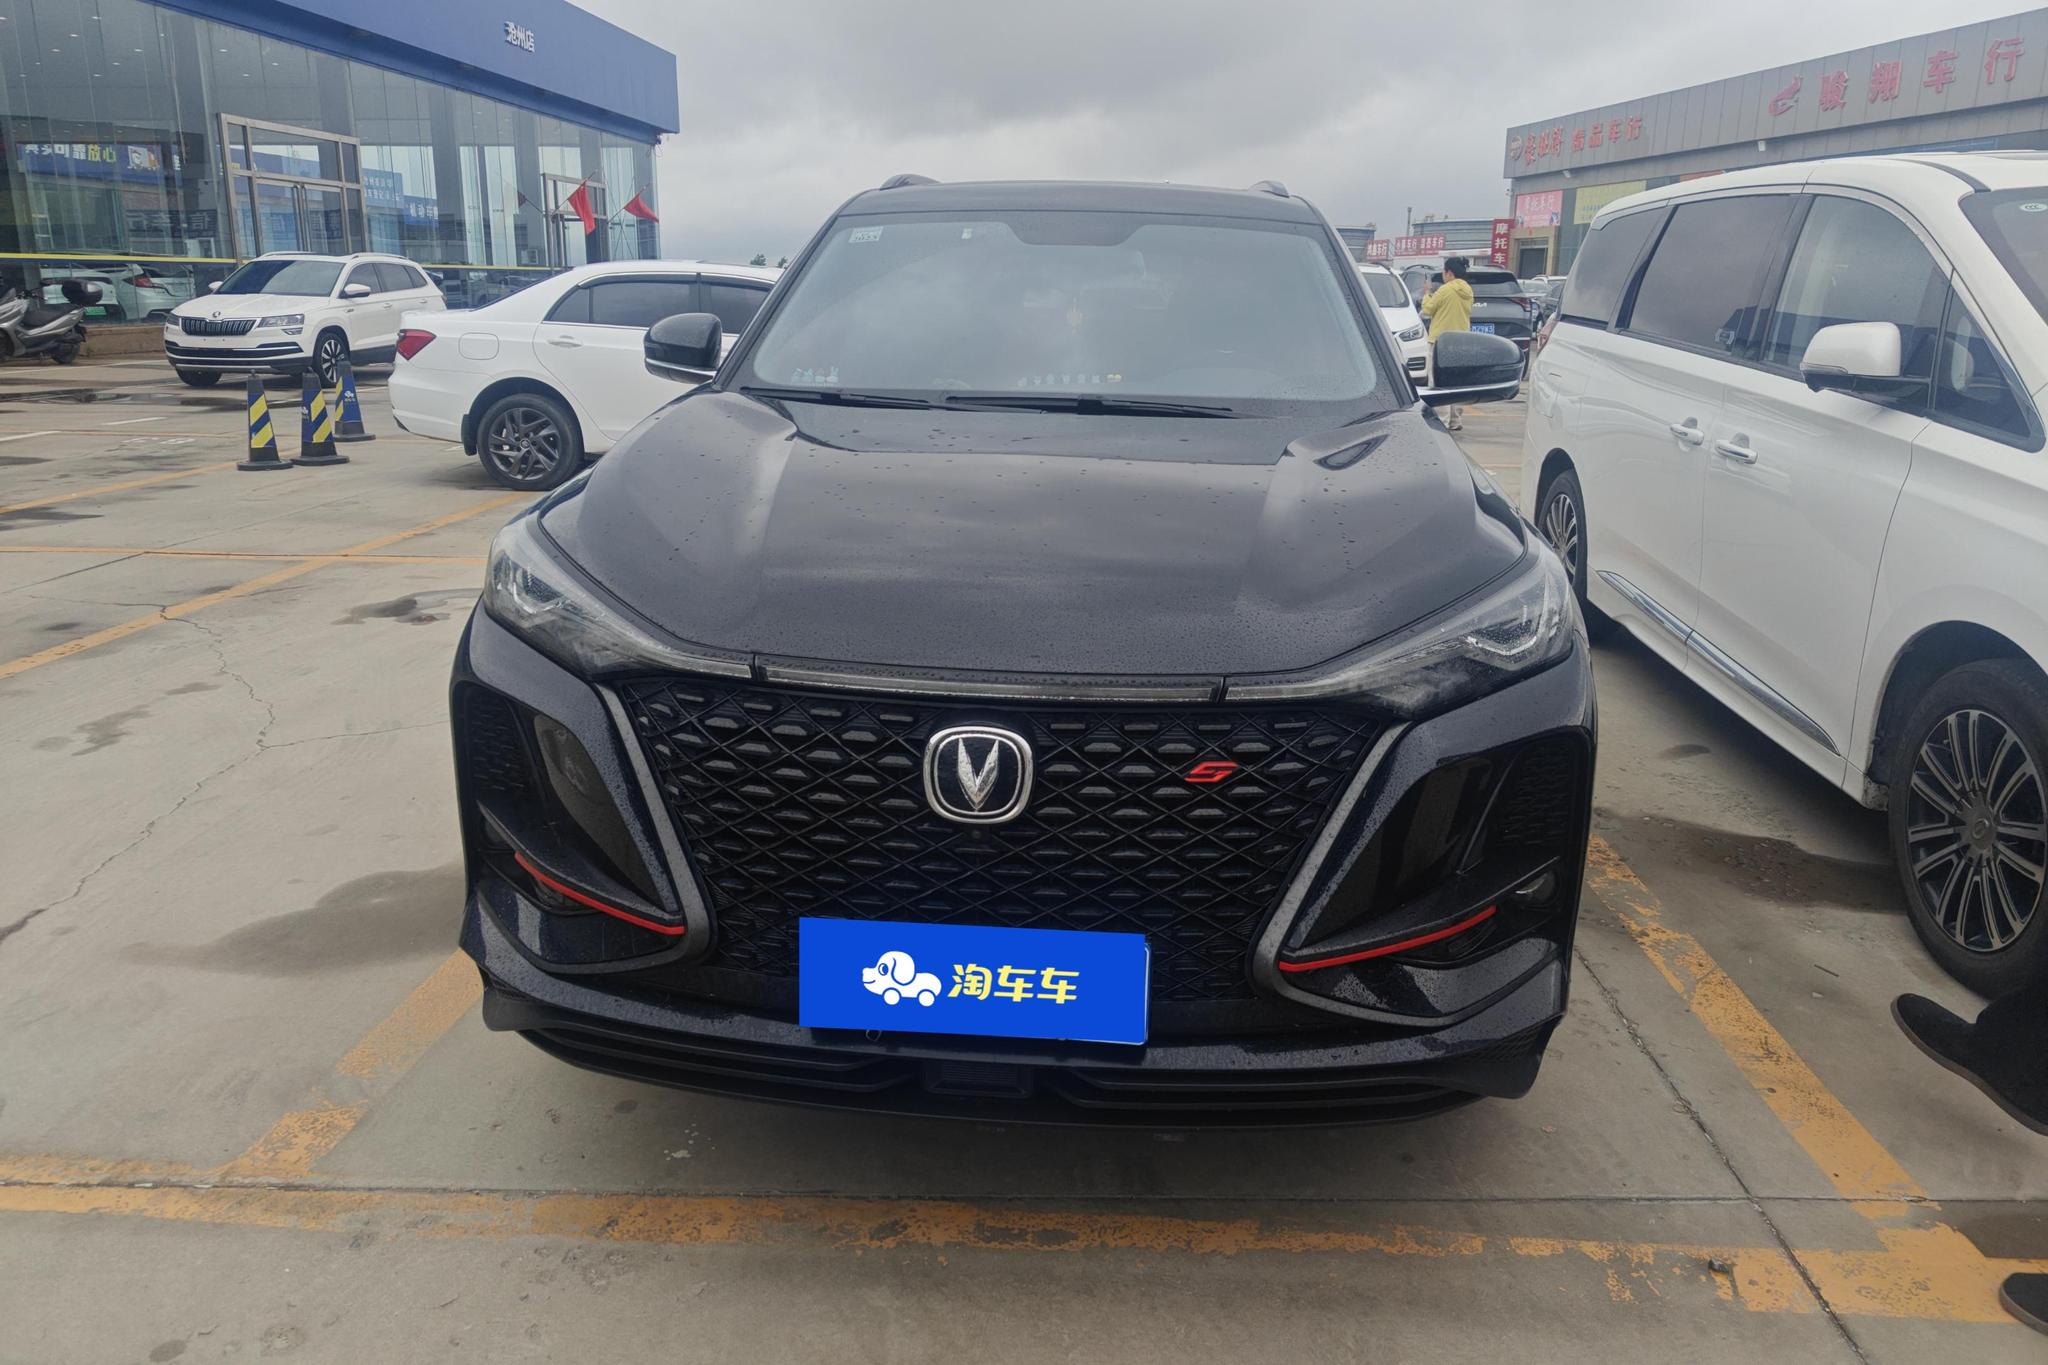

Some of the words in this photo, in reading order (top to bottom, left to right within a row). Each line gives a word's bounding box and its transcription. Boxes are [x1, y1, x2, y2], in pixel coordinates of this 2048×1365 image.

[1819, 36, 2025, 112] 骏翔车行
[1571, 115, 1642, 152] 精品车行
